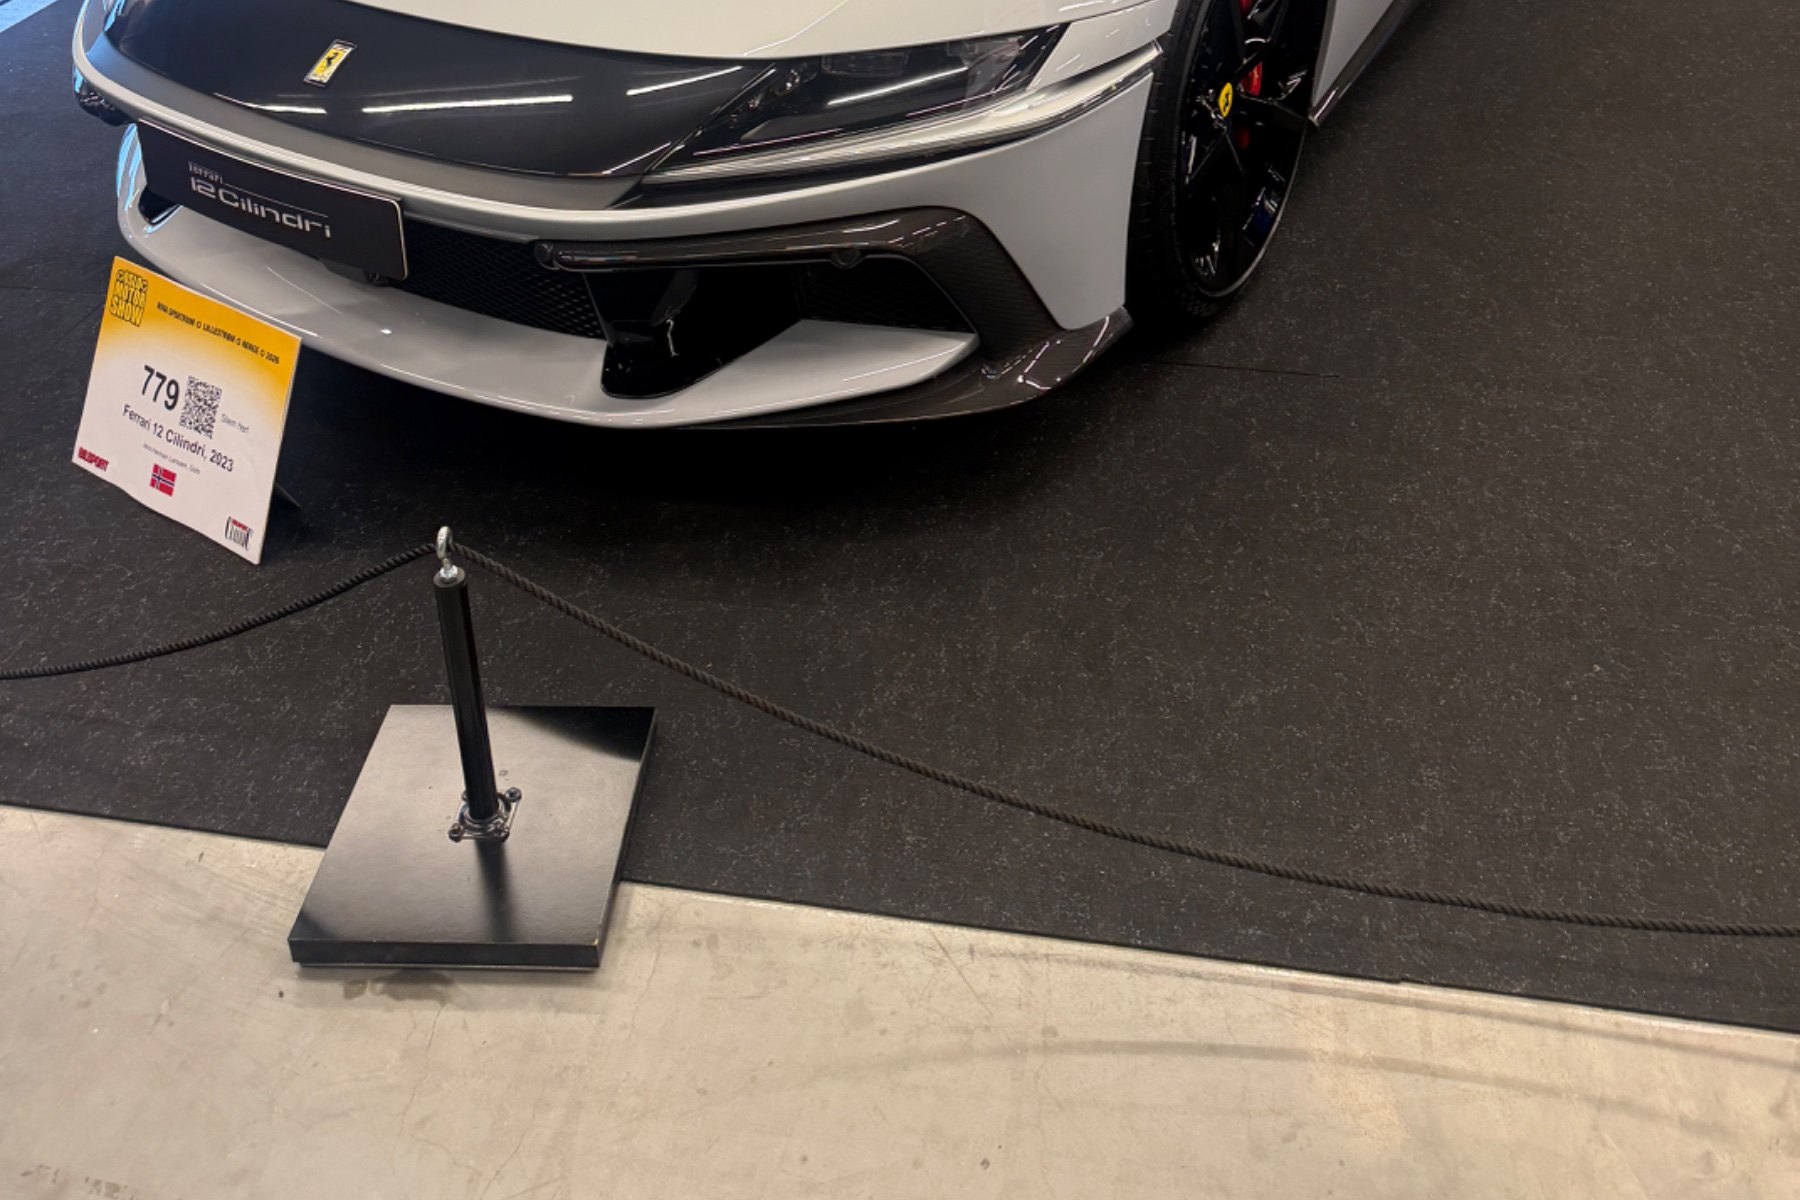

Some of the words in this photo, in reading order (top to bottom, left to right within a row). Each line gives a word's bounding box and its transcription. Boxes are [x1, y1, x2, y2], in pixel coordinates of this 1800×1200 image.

[109, 295, 145, 328] SHOW
[141, 364, 180, 411] 779
[122, 403, 153, 432] Ferrari
[152, 421, 165, 439] 12
[209, 448, 235, 472] 2023
